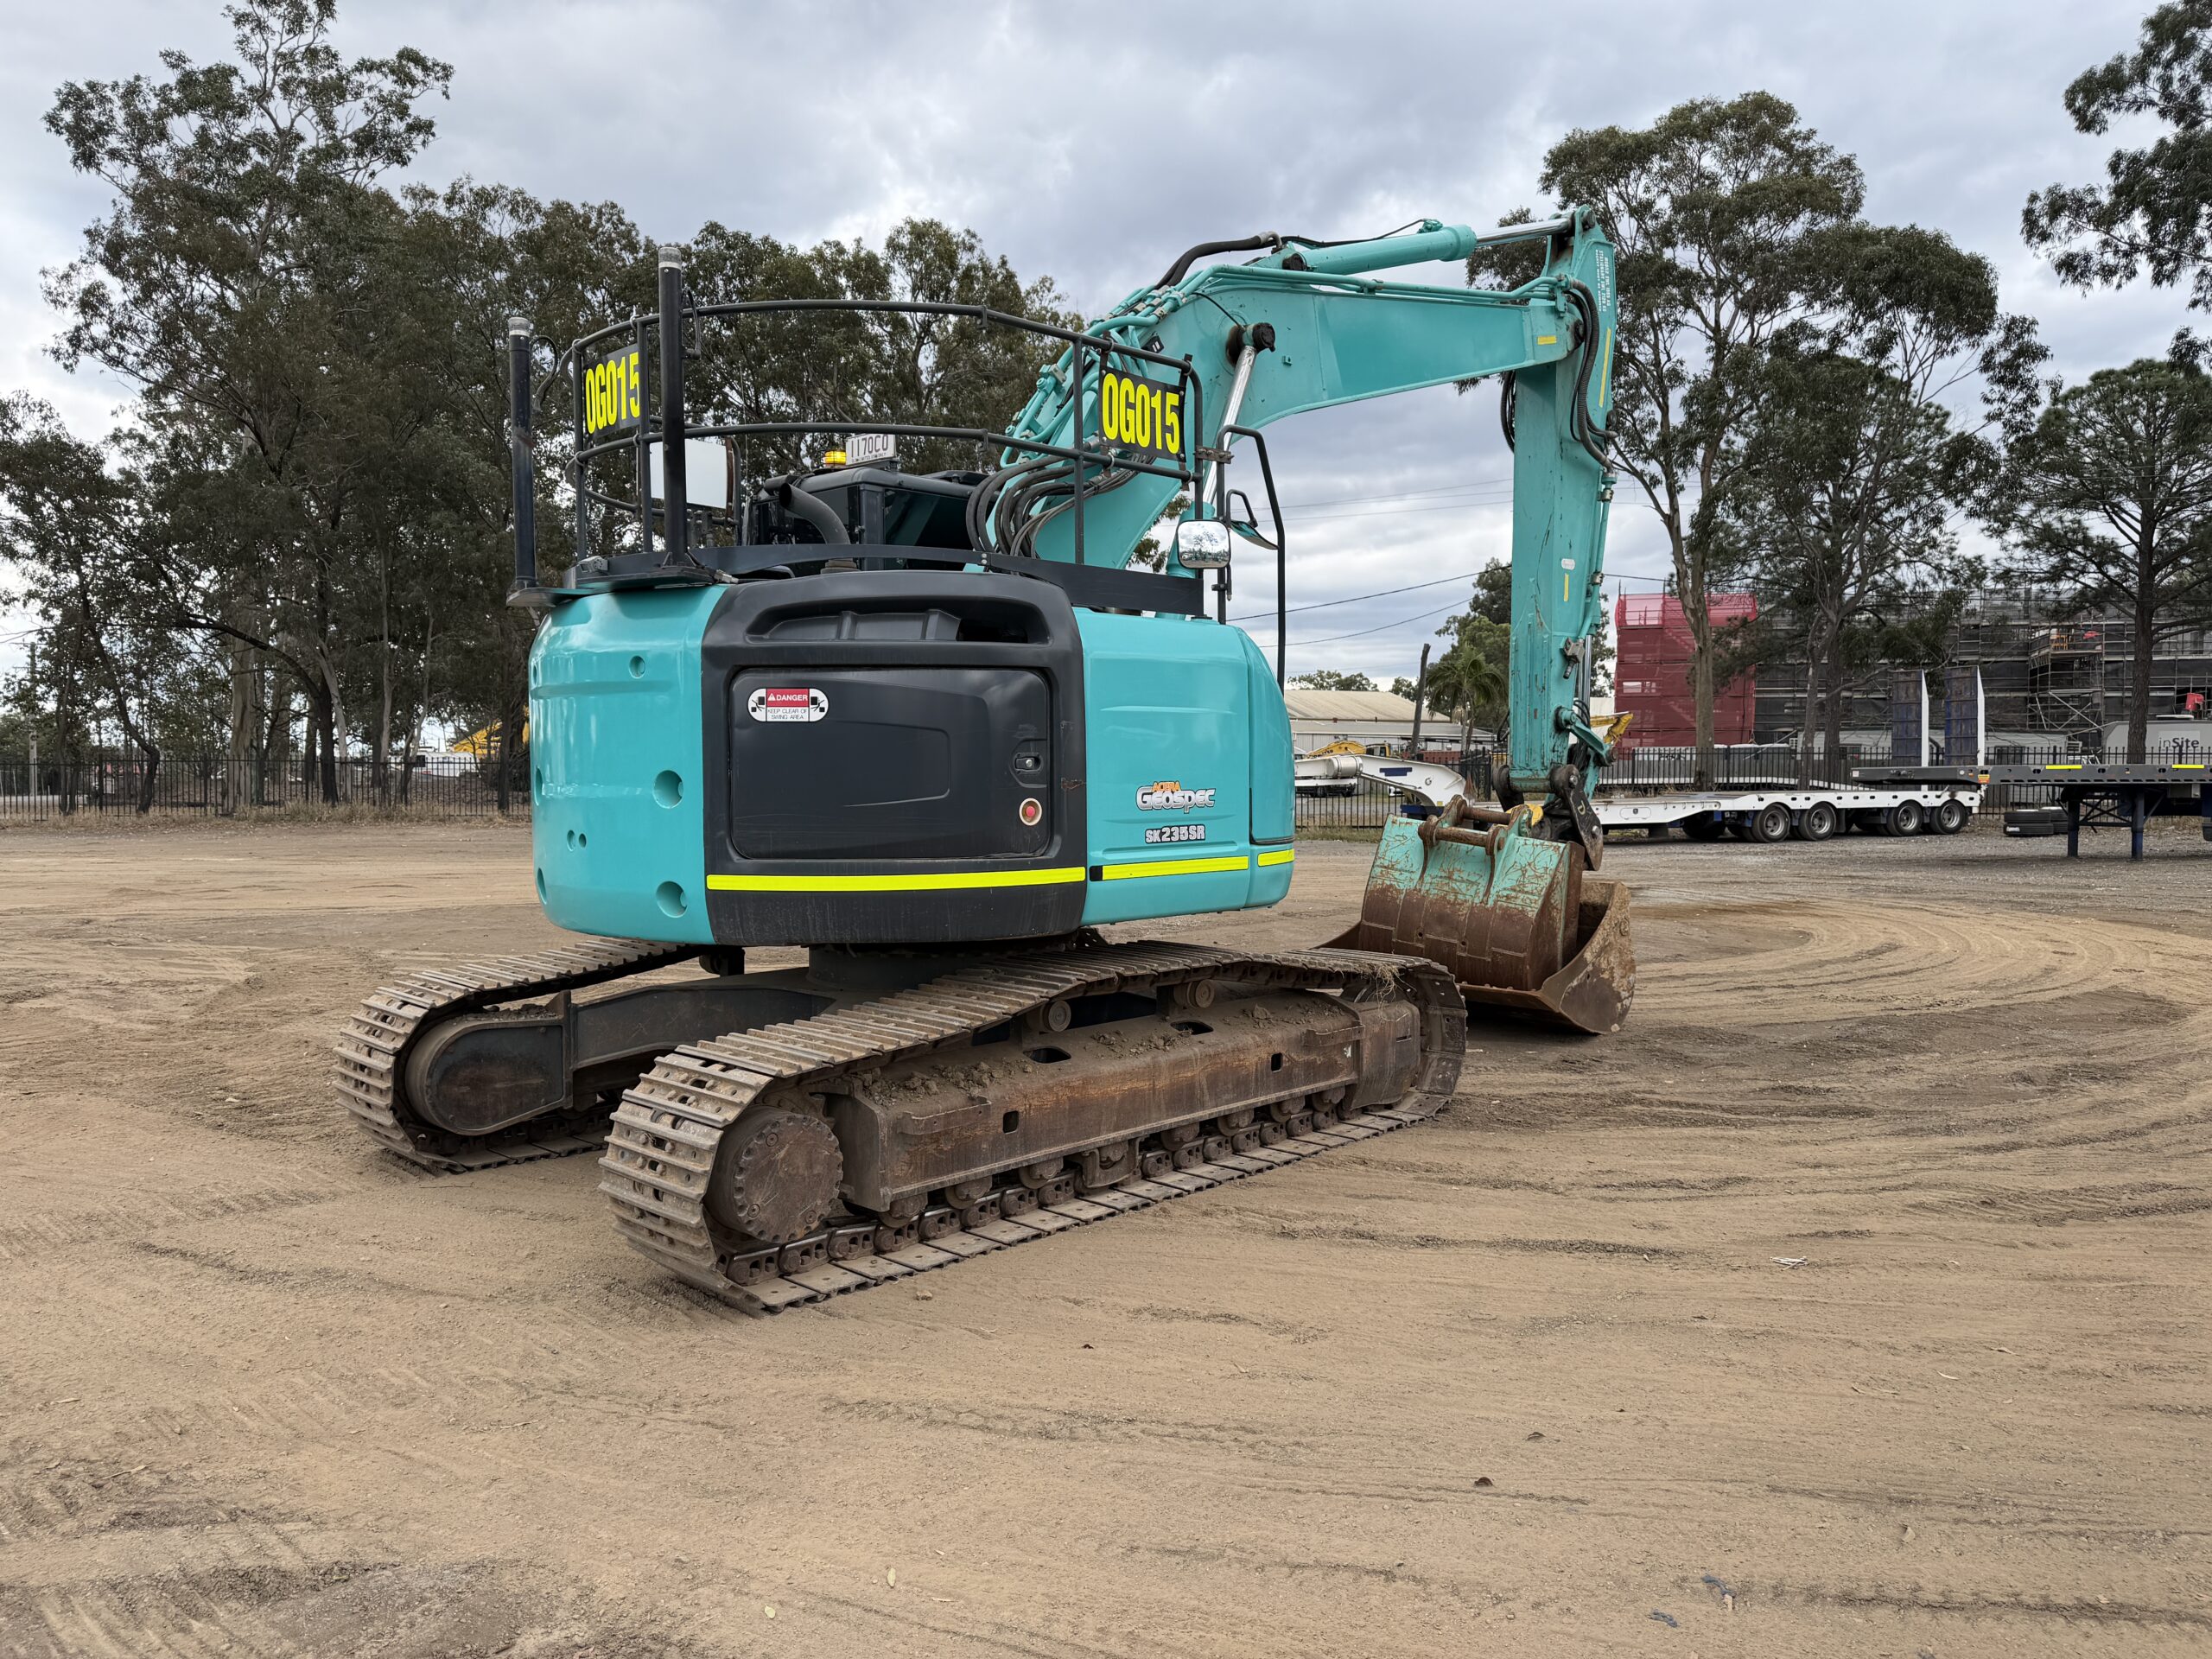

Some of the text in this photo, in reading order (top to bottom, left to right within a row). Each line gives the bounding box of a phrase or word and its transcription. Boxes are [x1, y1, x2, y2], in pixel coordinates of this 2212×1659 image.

[2158, 736, 2200, 748] inSite
[1152, 780, 1181, 792] ACERA
[1145, 824, 1205, 844] SK235SR
